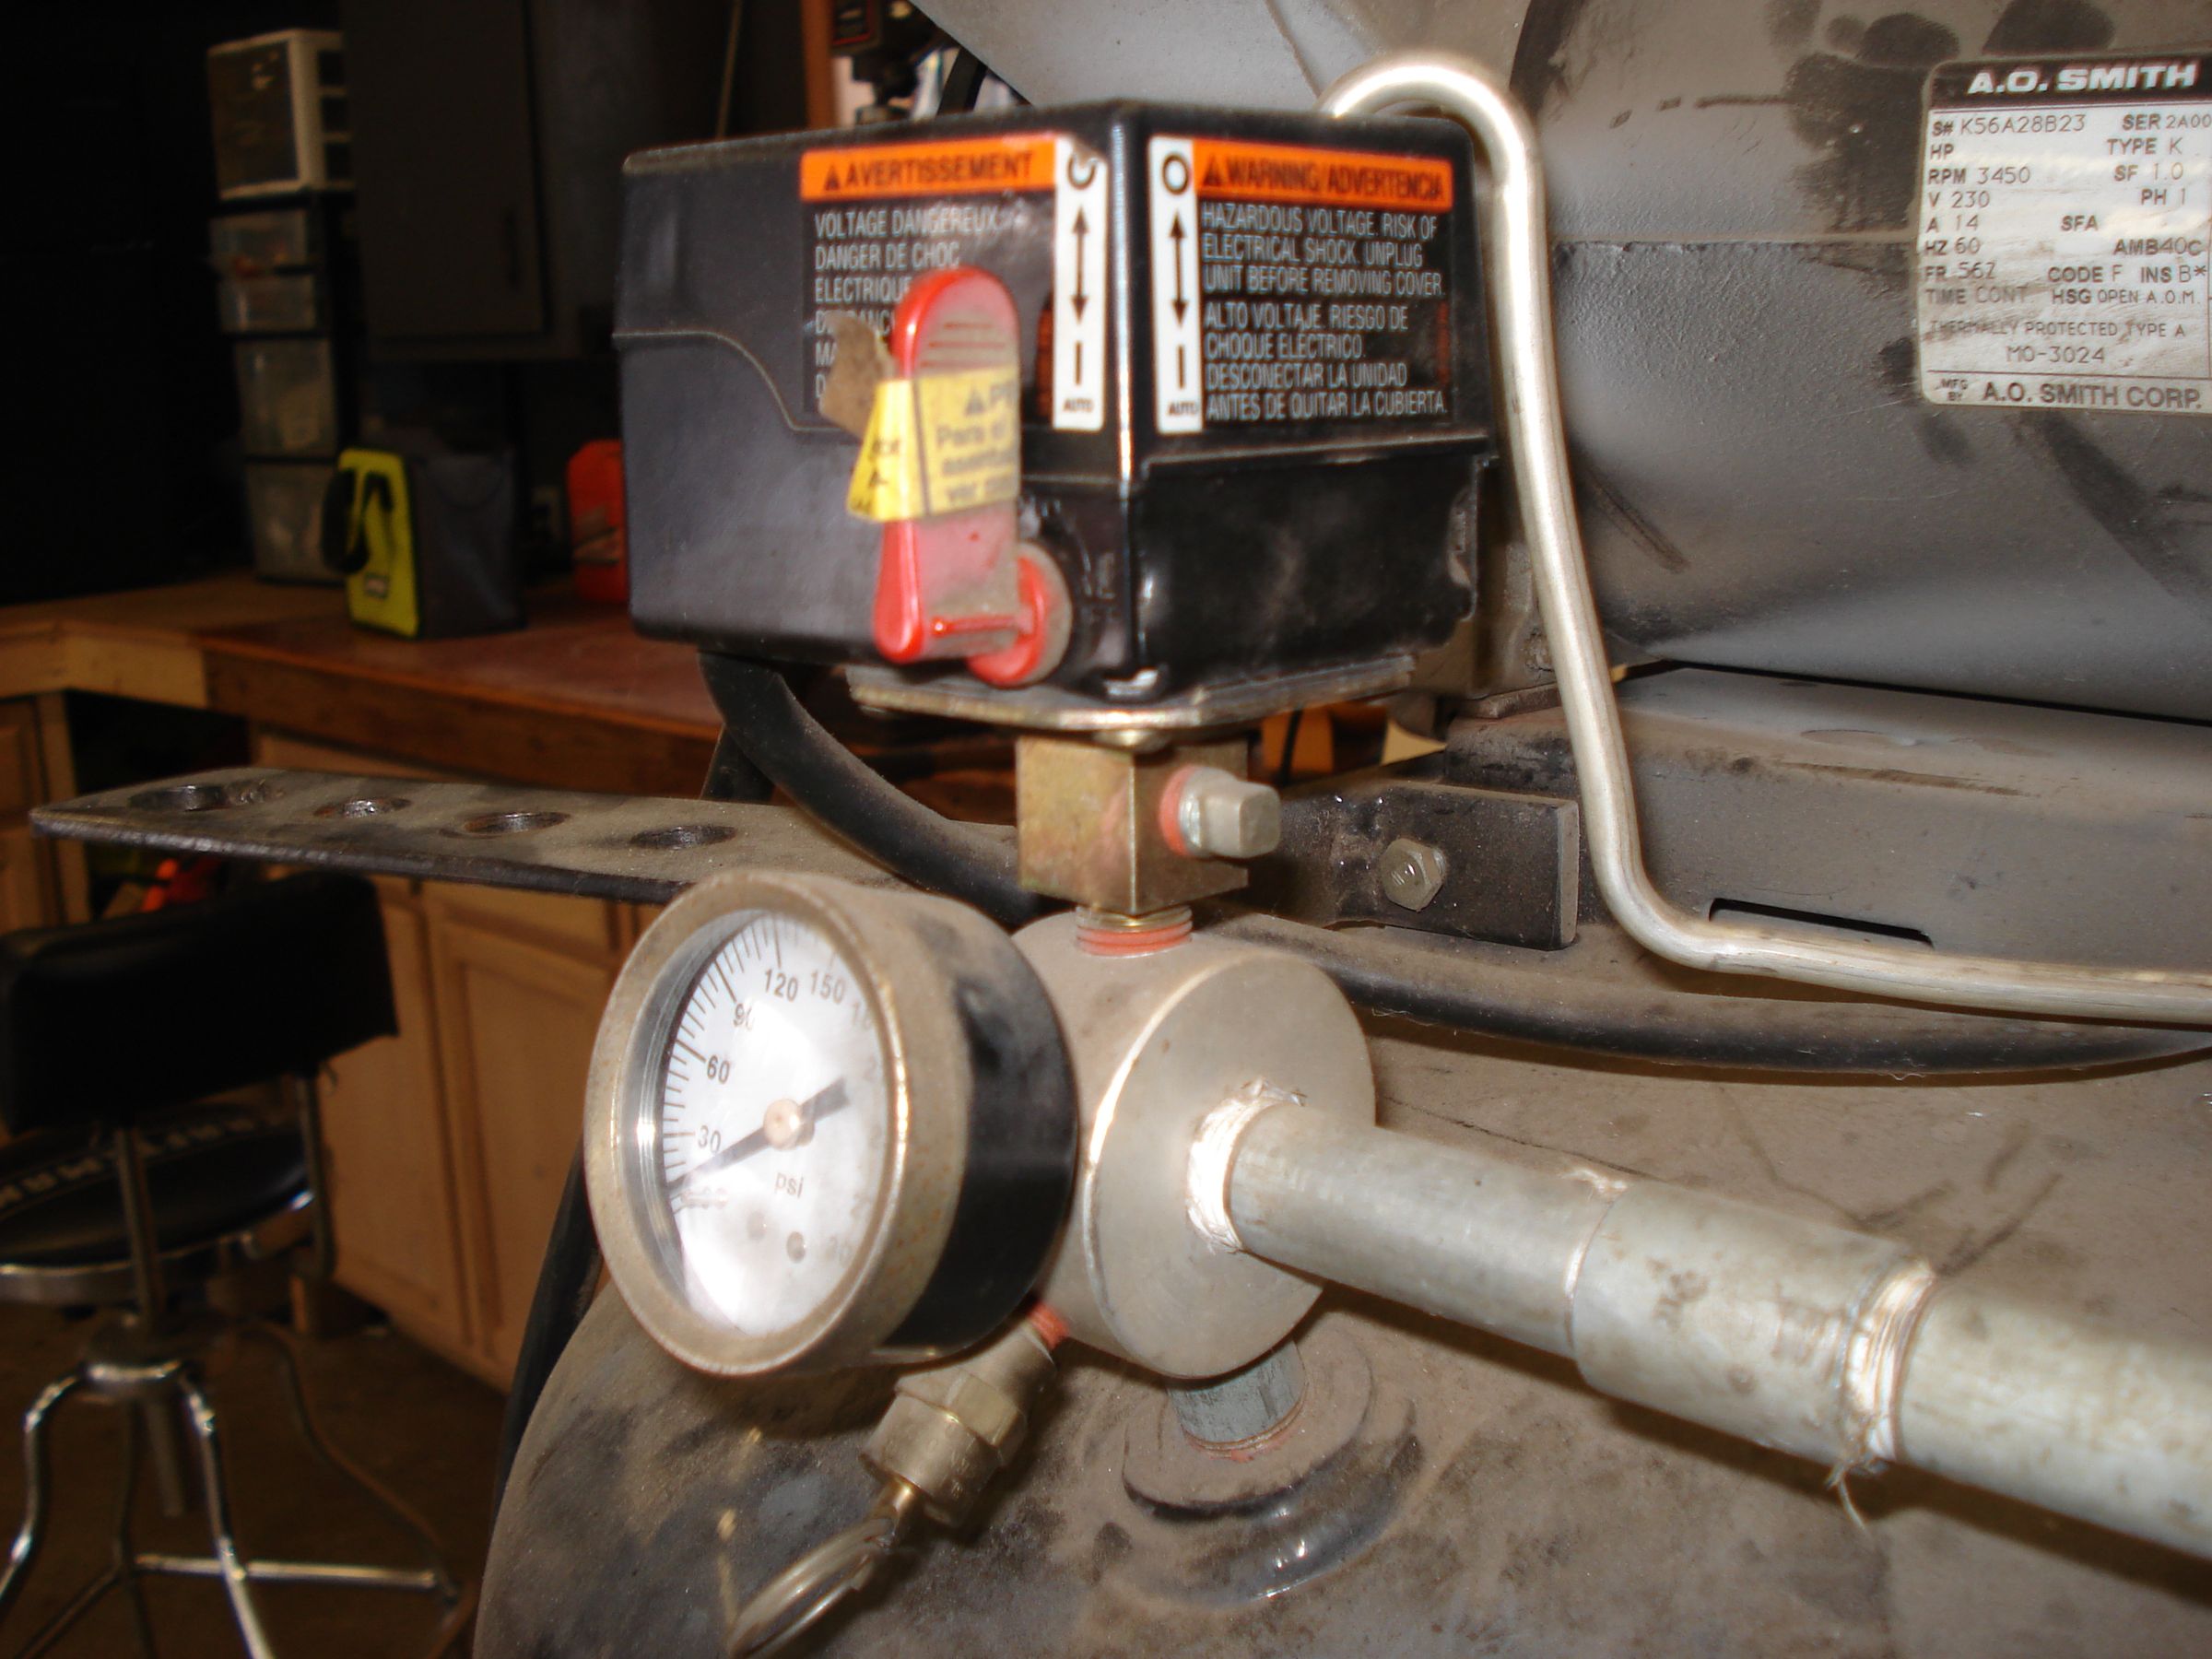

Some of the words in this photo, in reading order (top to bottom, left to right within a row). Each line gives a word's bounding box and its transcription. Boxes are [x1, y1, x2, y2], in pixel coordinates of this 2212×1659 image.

[1968, 70, 2049, 94] A.O.
[2057, 64, 2198, 91] SMITH
[1960, 114, 2086, 135] K56A28B23
[2122, 113, 2161, 131] SER
[1930, 143, 1954, 159] HP
[2107, 137, 2158, 155] TYPE
[2169, 137, 2184, 155] K
[845, 151, 1034, 186] AVERTISSEMENT
[1928, 168, 1966, 184] RPM
[1977, 166, 2030, 184] 3450
[2113, 164, 2138, 182] SF
[1928, 192, 1940, 207] V
[1951, 191, 1990, 208] 230
[2140, 188, 2168, 206] PH
[815, 208, 887, 239] VOLTAGE
[1202, 202, 1303, 233] HAZARDOUS
[1382, 212, 1417, 239] RISK
[1420, 215, 1438, 241] OF
[1925, 218, 1939, 233] A
[1956, 215, 1979, 230] 14
[2061, 215, 2099, 231] SFA
[816, 243, 881, 270] DANGER
[885, 242, 907, 270] DE
[912, 241, 959, 270] CHOC
[1202, 232, 1300, 263] ELECTRICAL
[1364, 241, 1423, 267] UNPLUG
[1924, 240, 1947, 255] HZ
[1954, 237, 1981, 254] 60
[1203, 265, 1243, 293] UNIT
[1247, 265, 1309, 293] BEFORE
[1312, 267, 1392, 295] REMOVING
[2048, 266, 2103, 283] CODE
[2112, 265, 2123, 282] F
[2140, 266, 2171, 283] INS
[1925, 288, 1967, 304] TIME
[2052, 288, 2092, 305] HSG
[2098, 288, 2138, 304] OPEN
[1204, 301, 1249, 329] ALTO
[1328, 303, 1386, 330] RIESGO
[1389, 305, 1409, 330] DE
[2025, 322, 2118, 337] PROTECTED
[2124, 324, 2167, 337] TYPE
[2174, 324, 2186, 337] A
[1205, 332, 1275, 359] CHOQUE
[1205, 362, 1324, 391] DESCONECTAR
[1327, 363, 1349, 388] LA
[1351, 362, 1408, 387] UNIDAD
[1206, 392, 1261, 421] ANTES
[1264, 393, 1287, 420] DE
[1290, 392, 1348, 418] QUITAR
[1350, 392, 1371, 418] LA
[1983, 381, 2032, 402] A.O.
[2040, 383, 2119, 406] SMITH
[2126, 386, 2202, 409] CORP.
[764, 968, 799, 1001] 120
[809, 970, 846, 1005] 150
[706, 1053, 731, 1085] 60
[697, 1124, 723, 1155] 30
[774, 1171, 805, 1199] psi
